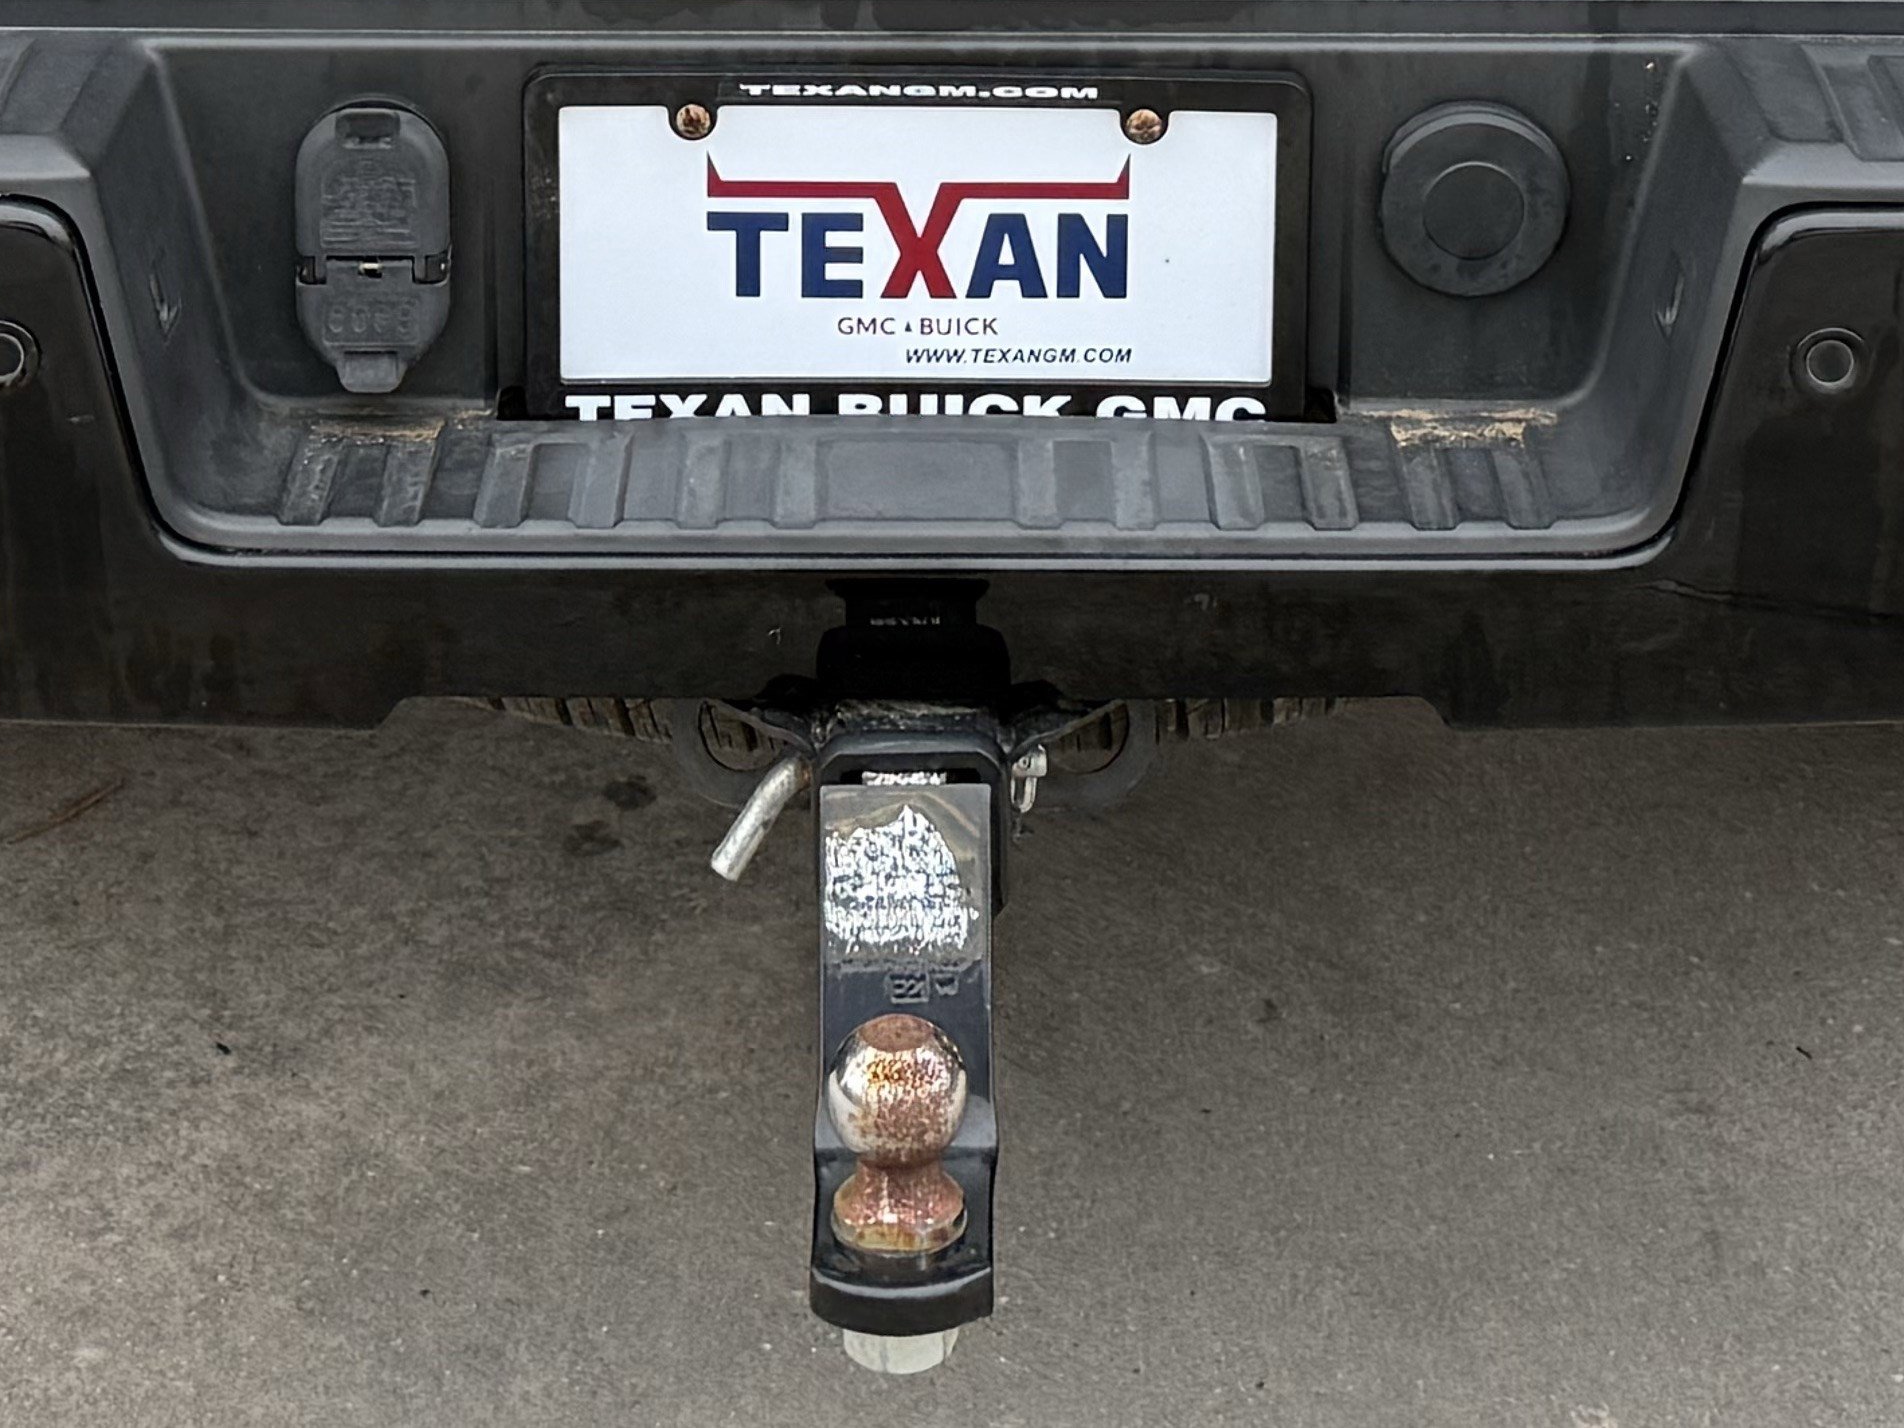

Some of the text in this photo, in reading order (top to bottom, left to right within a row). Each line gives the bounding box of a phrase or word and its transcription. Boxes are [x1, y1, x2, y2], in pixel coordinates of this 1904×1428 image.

[740, 84, 1098, 99] TEXANGM.COM
[706, 180, 1130, 299] TEXAN
[837, 317, 998, 336] GMC BUICK
[905, 348, 1132, 365] WWW.TEXANGM.COM
